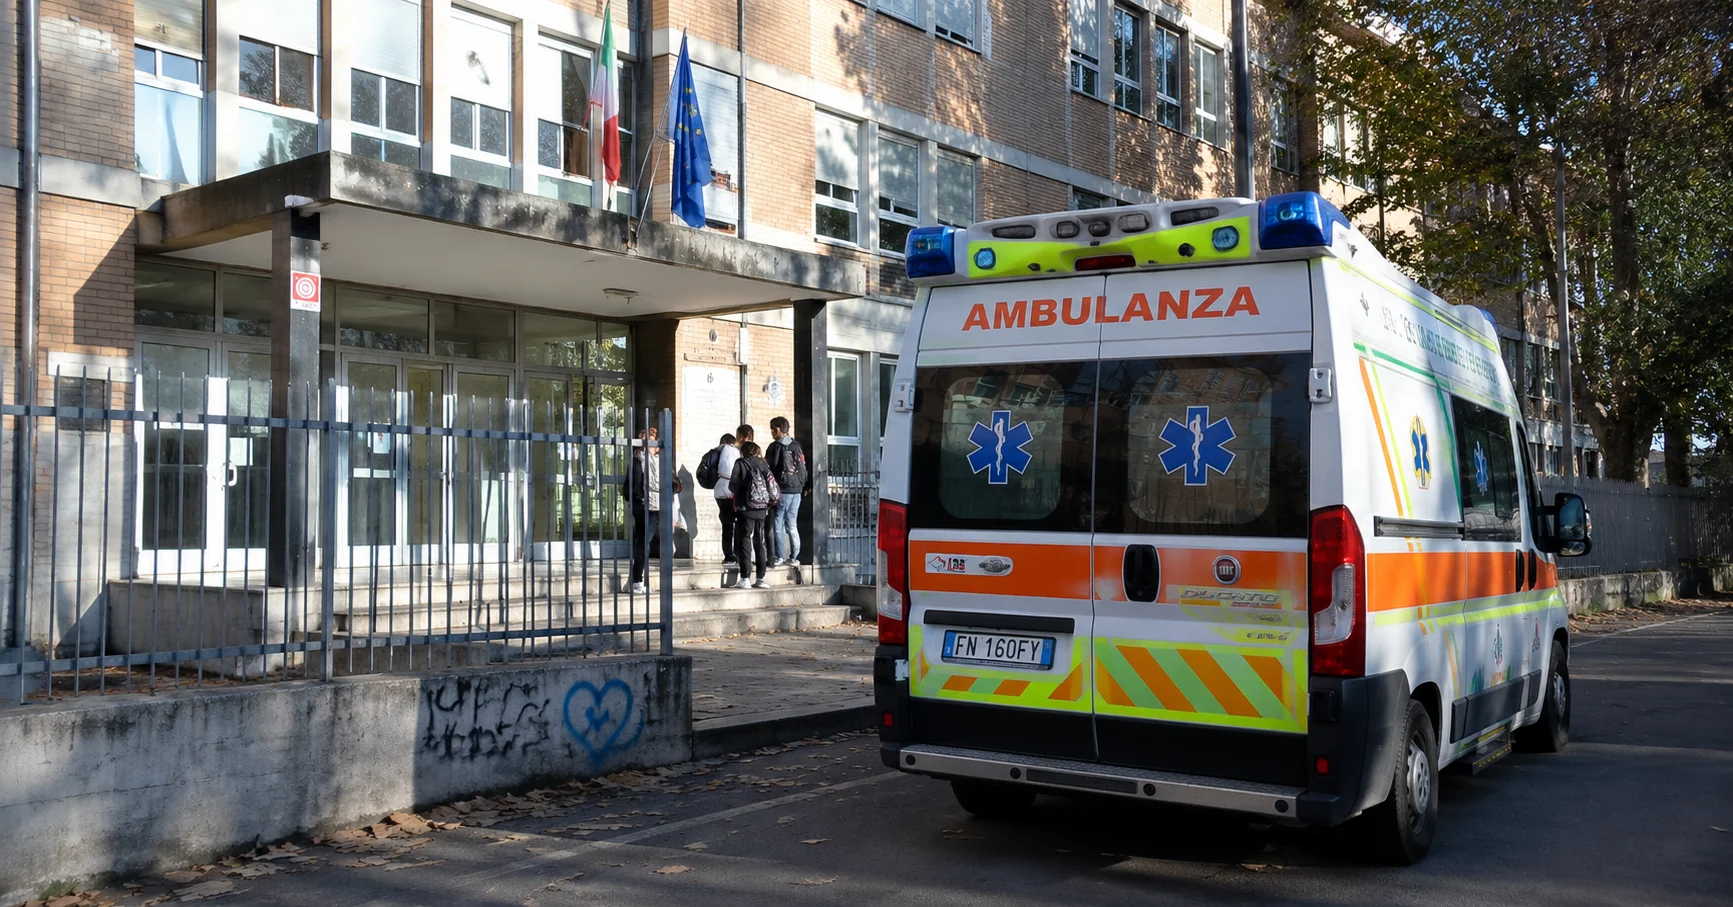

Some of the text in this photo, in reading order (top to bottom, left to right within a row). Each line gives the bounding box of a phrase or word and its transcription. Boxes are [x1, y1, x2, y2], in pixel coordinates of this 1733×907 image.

[962, 286, 1260, 331] AMBULANZA
[955, 636, 1040, 661] FN 160FY
